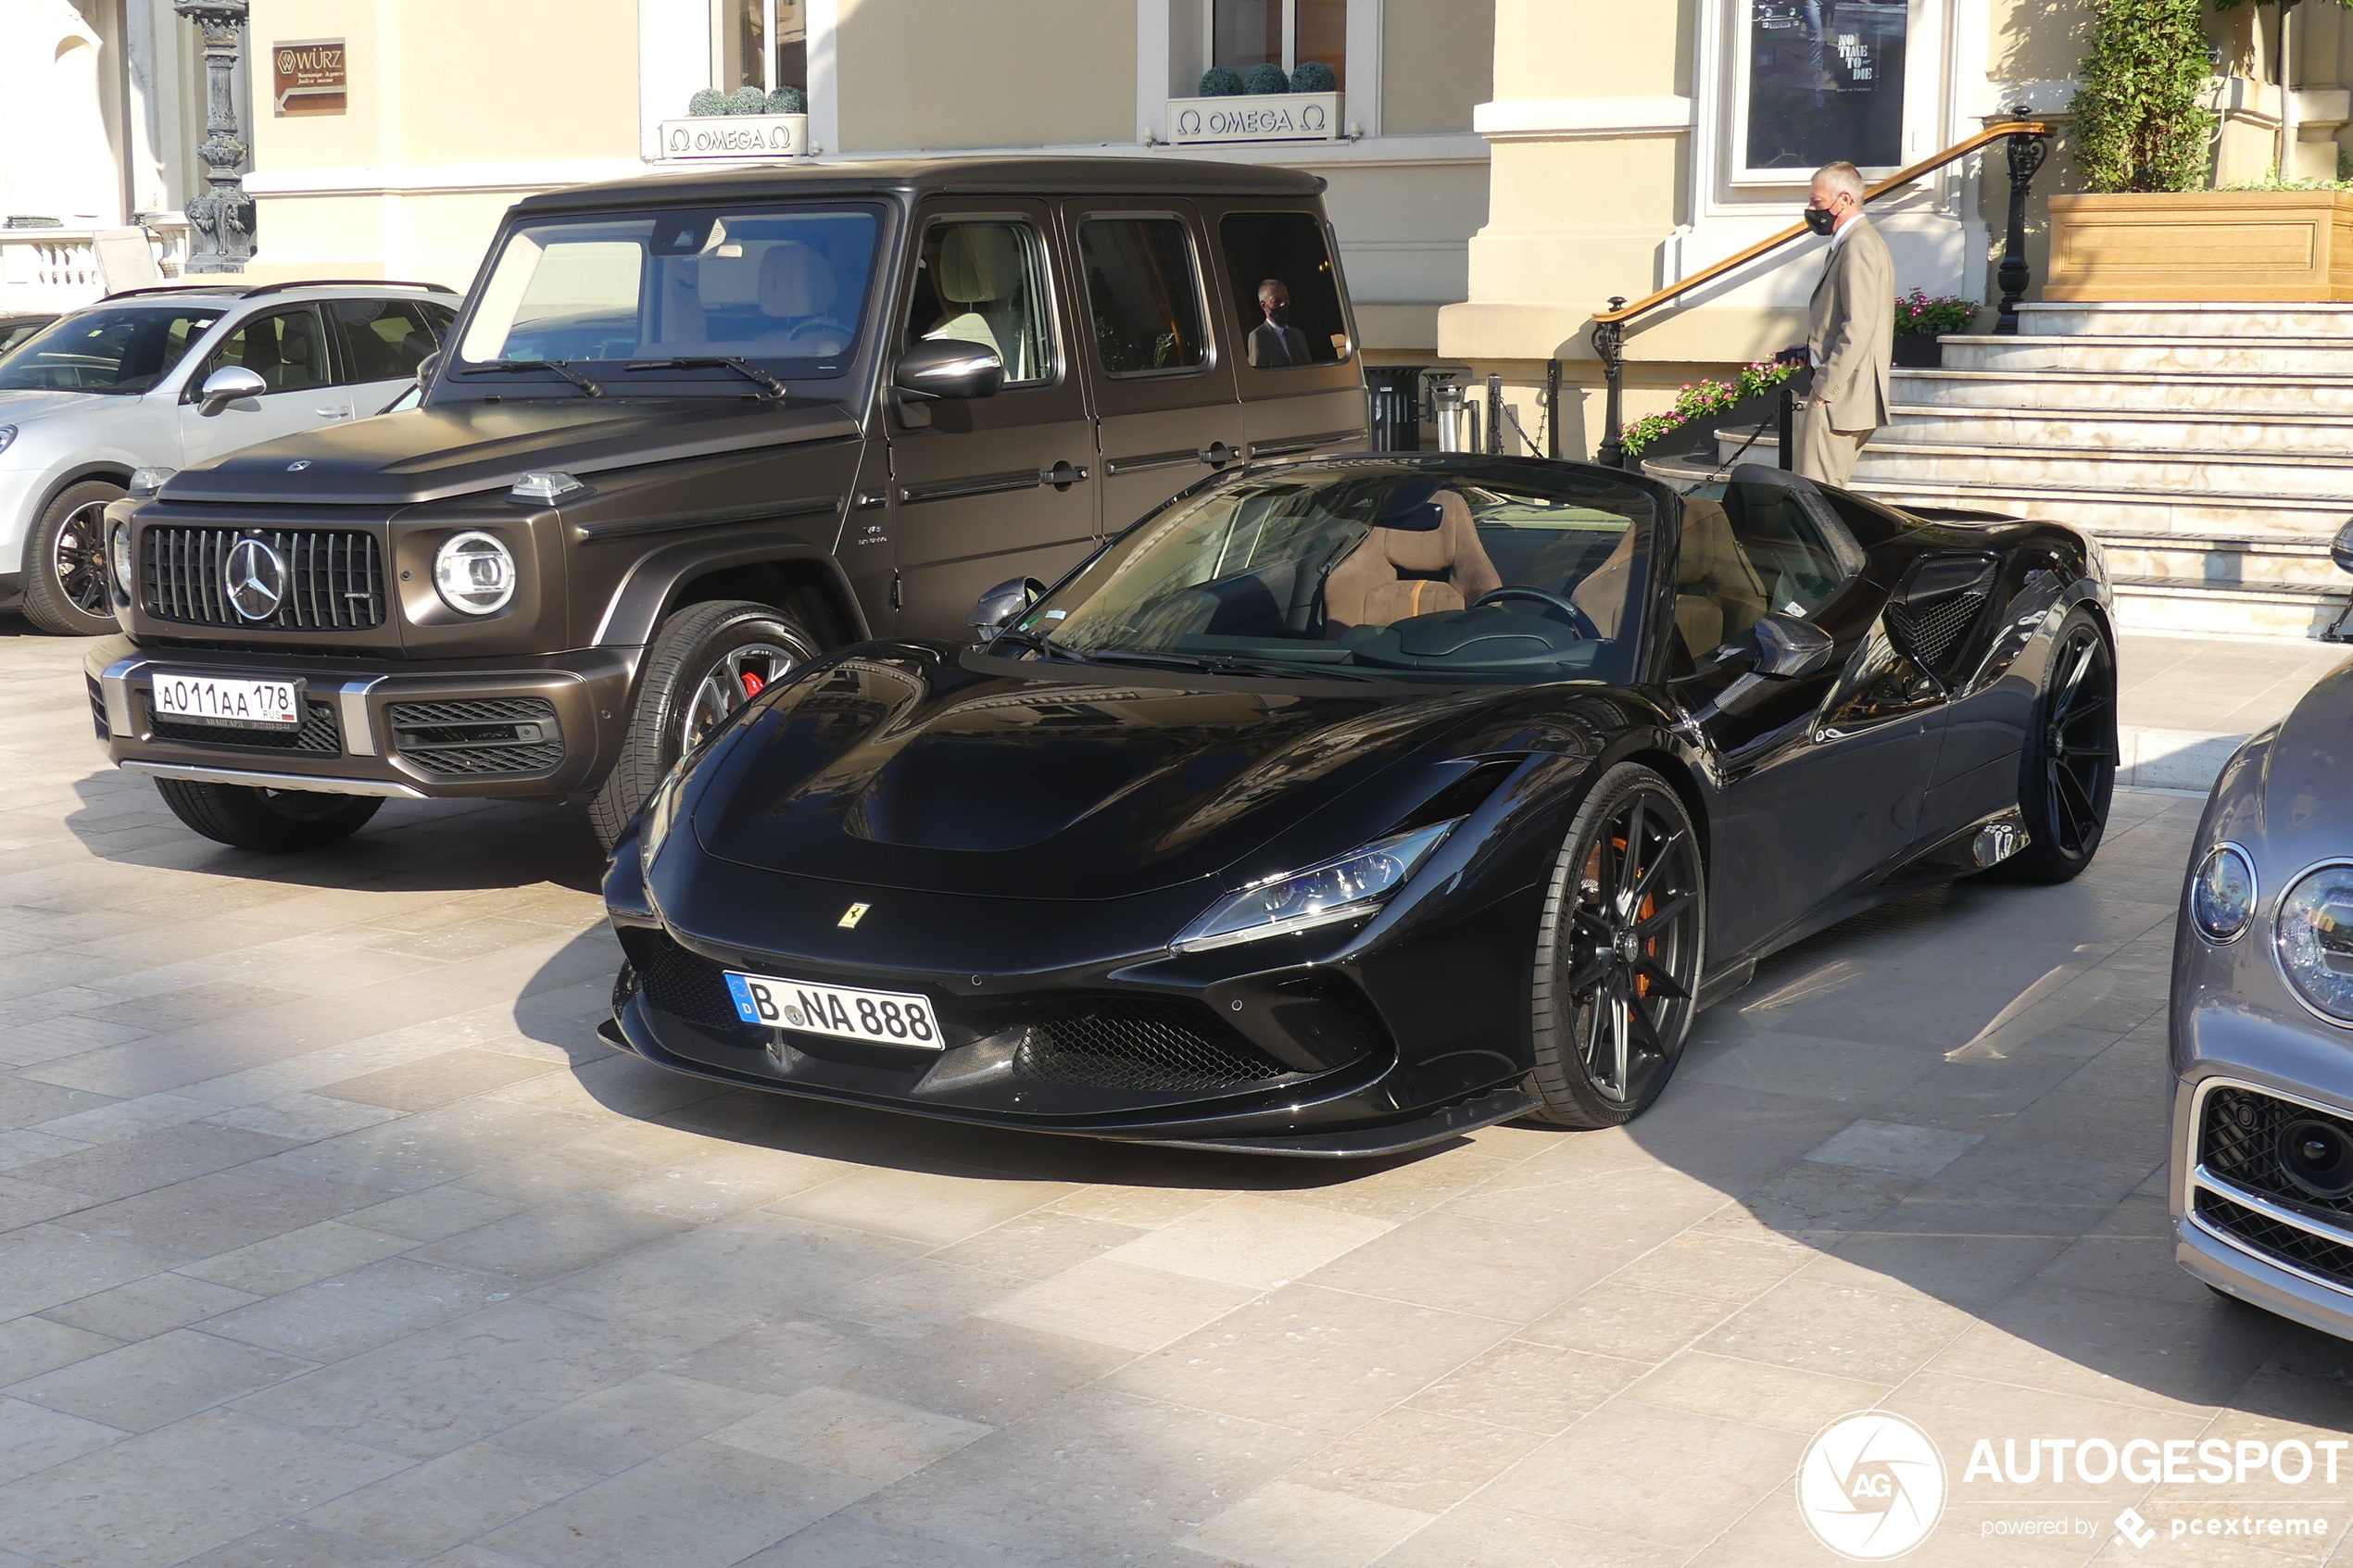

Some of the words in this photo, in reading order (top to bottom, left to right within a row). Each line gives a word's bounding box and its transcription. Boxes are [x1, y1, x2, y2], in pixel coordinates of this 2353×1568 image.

[1838, 34, 1855, 46] NO
[1838, 45, 1868, 57] TIME
[296, 47, 342, 69] WÜRZ
[1845, 57, 1862, 69] TO
[1853, 68, 1872, 80] DIE
[1208, 109, 1293, 133] OMEGA
[695, 129, 765, 151] OMEGA
[254, 684, 289, 710] 178
[263, 709, 281, 720] RUS
[742, 1003, 752, 1014] D
[749, 983, 780, 1021] B
[797, 988, 855, 1033] NA
[855, 997, 933, 1041] 888
